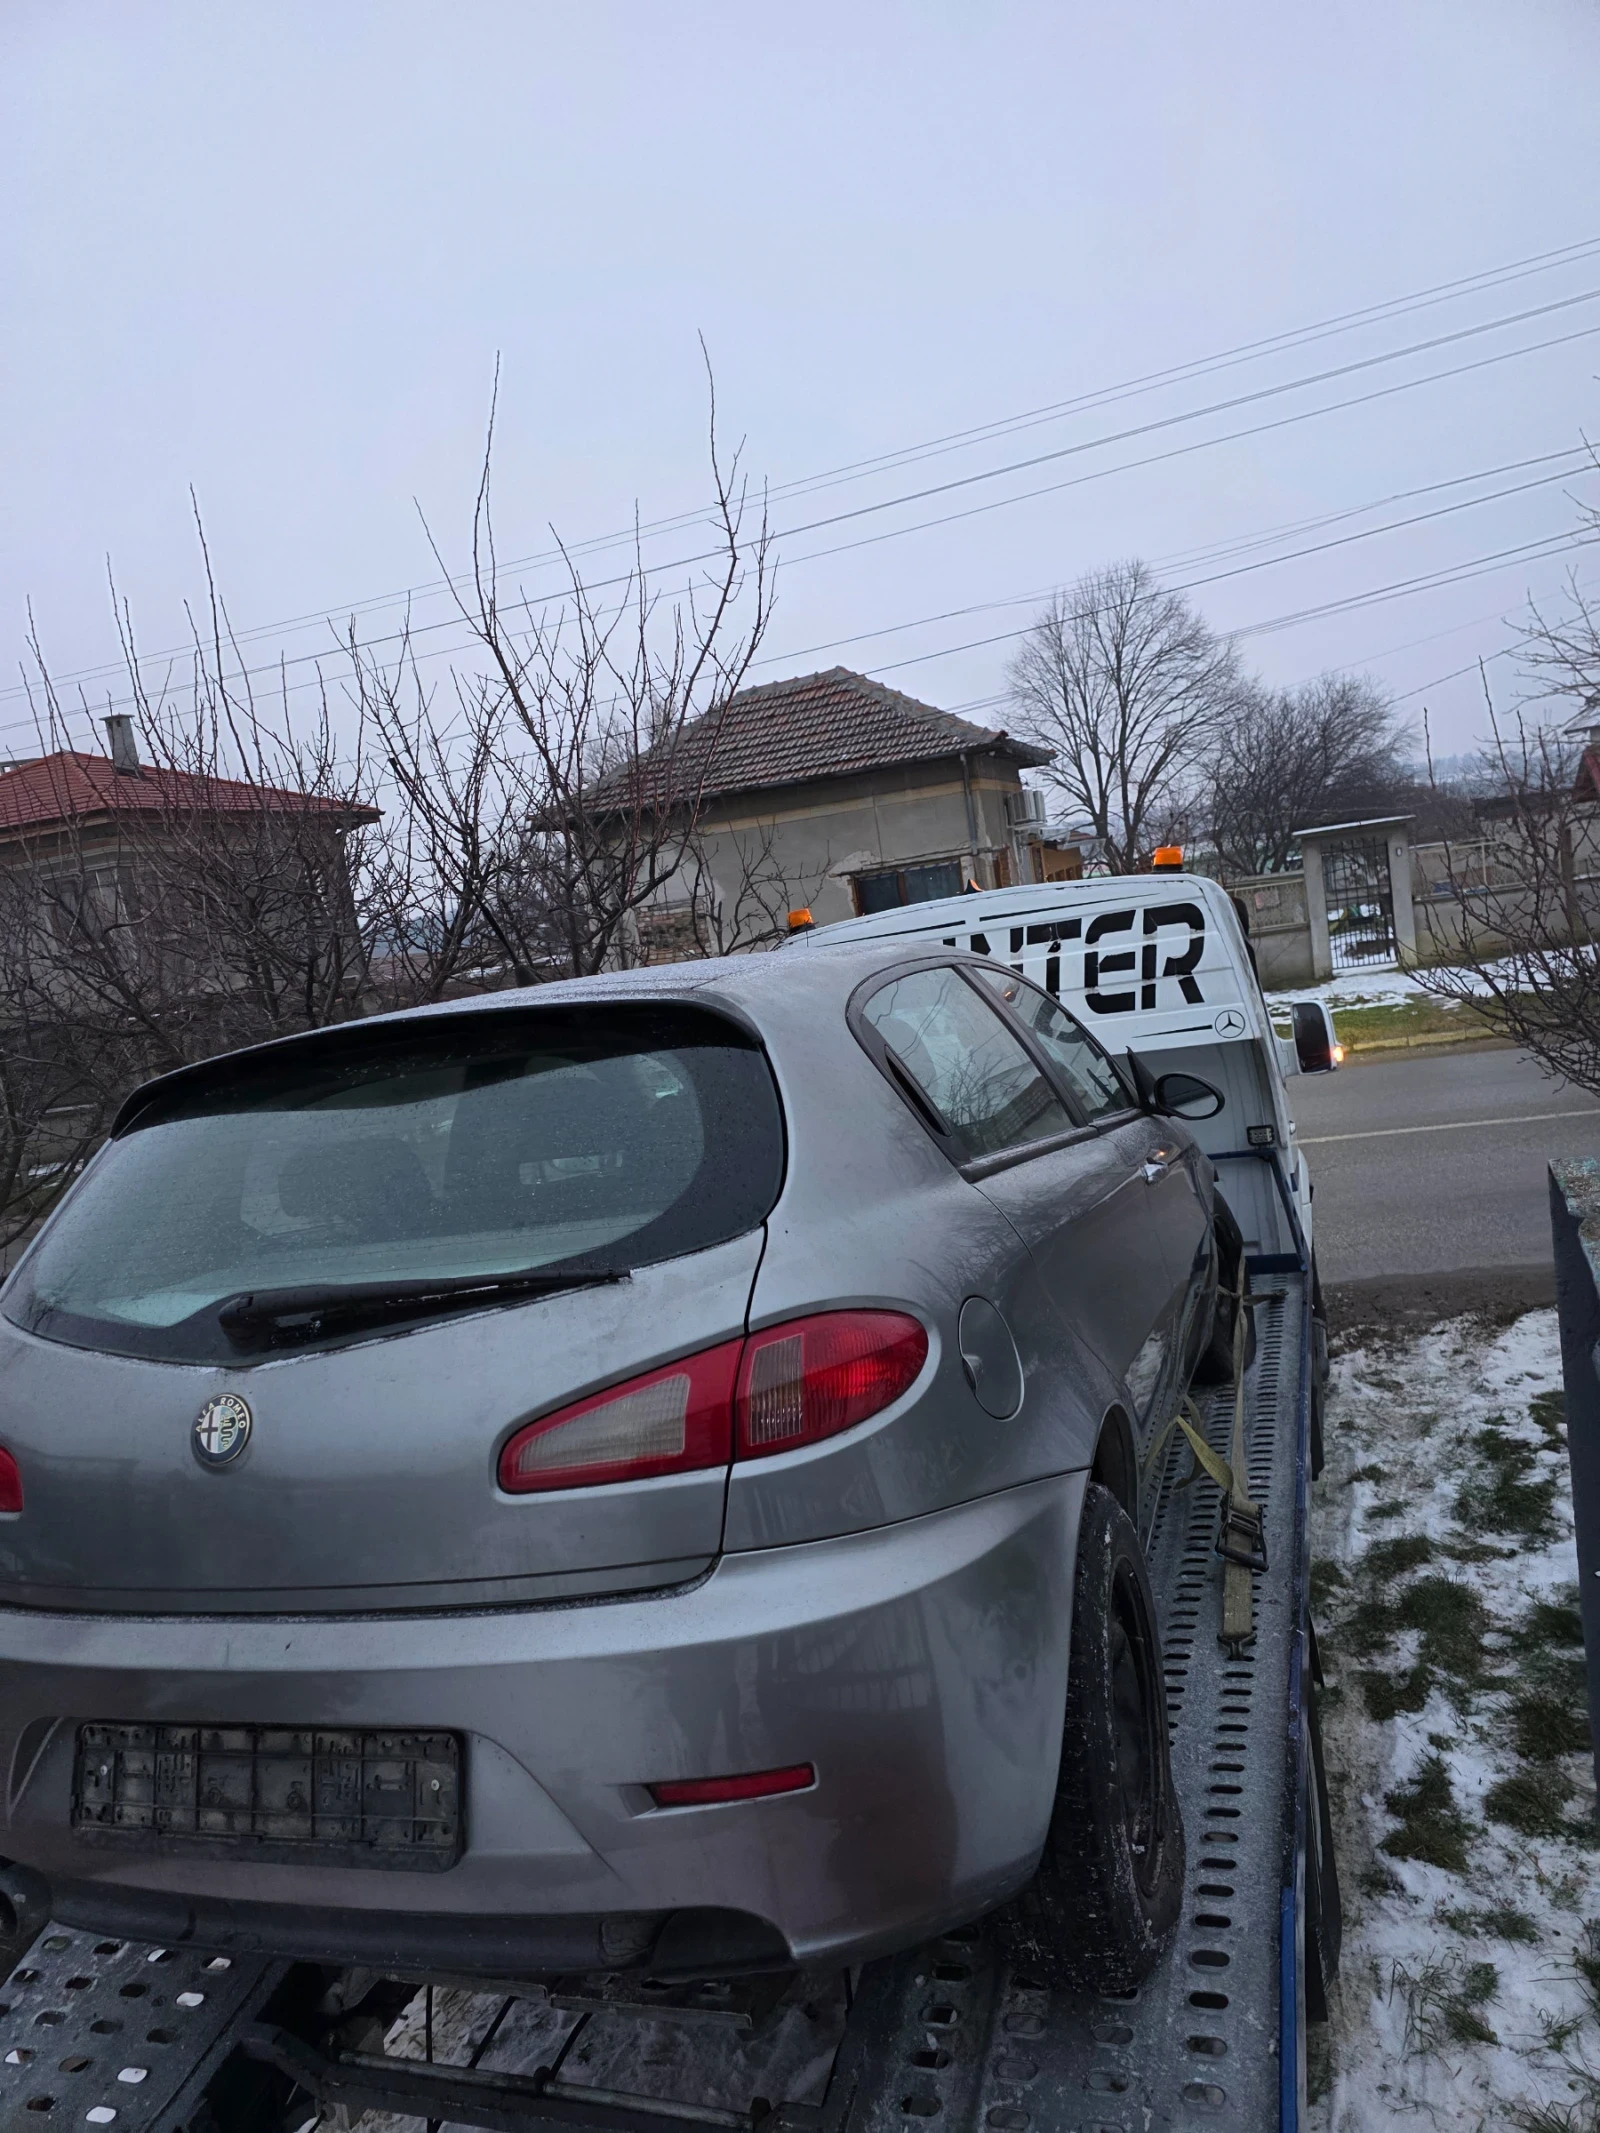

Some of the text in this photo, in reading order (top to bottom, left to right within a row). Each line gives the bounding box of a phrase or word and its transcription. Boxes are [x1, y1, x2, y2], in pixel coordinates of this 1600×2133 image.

[943, 903, 1205, 1014] NTER
[196, 1397, 246, 1432] ALFA ROMEO
